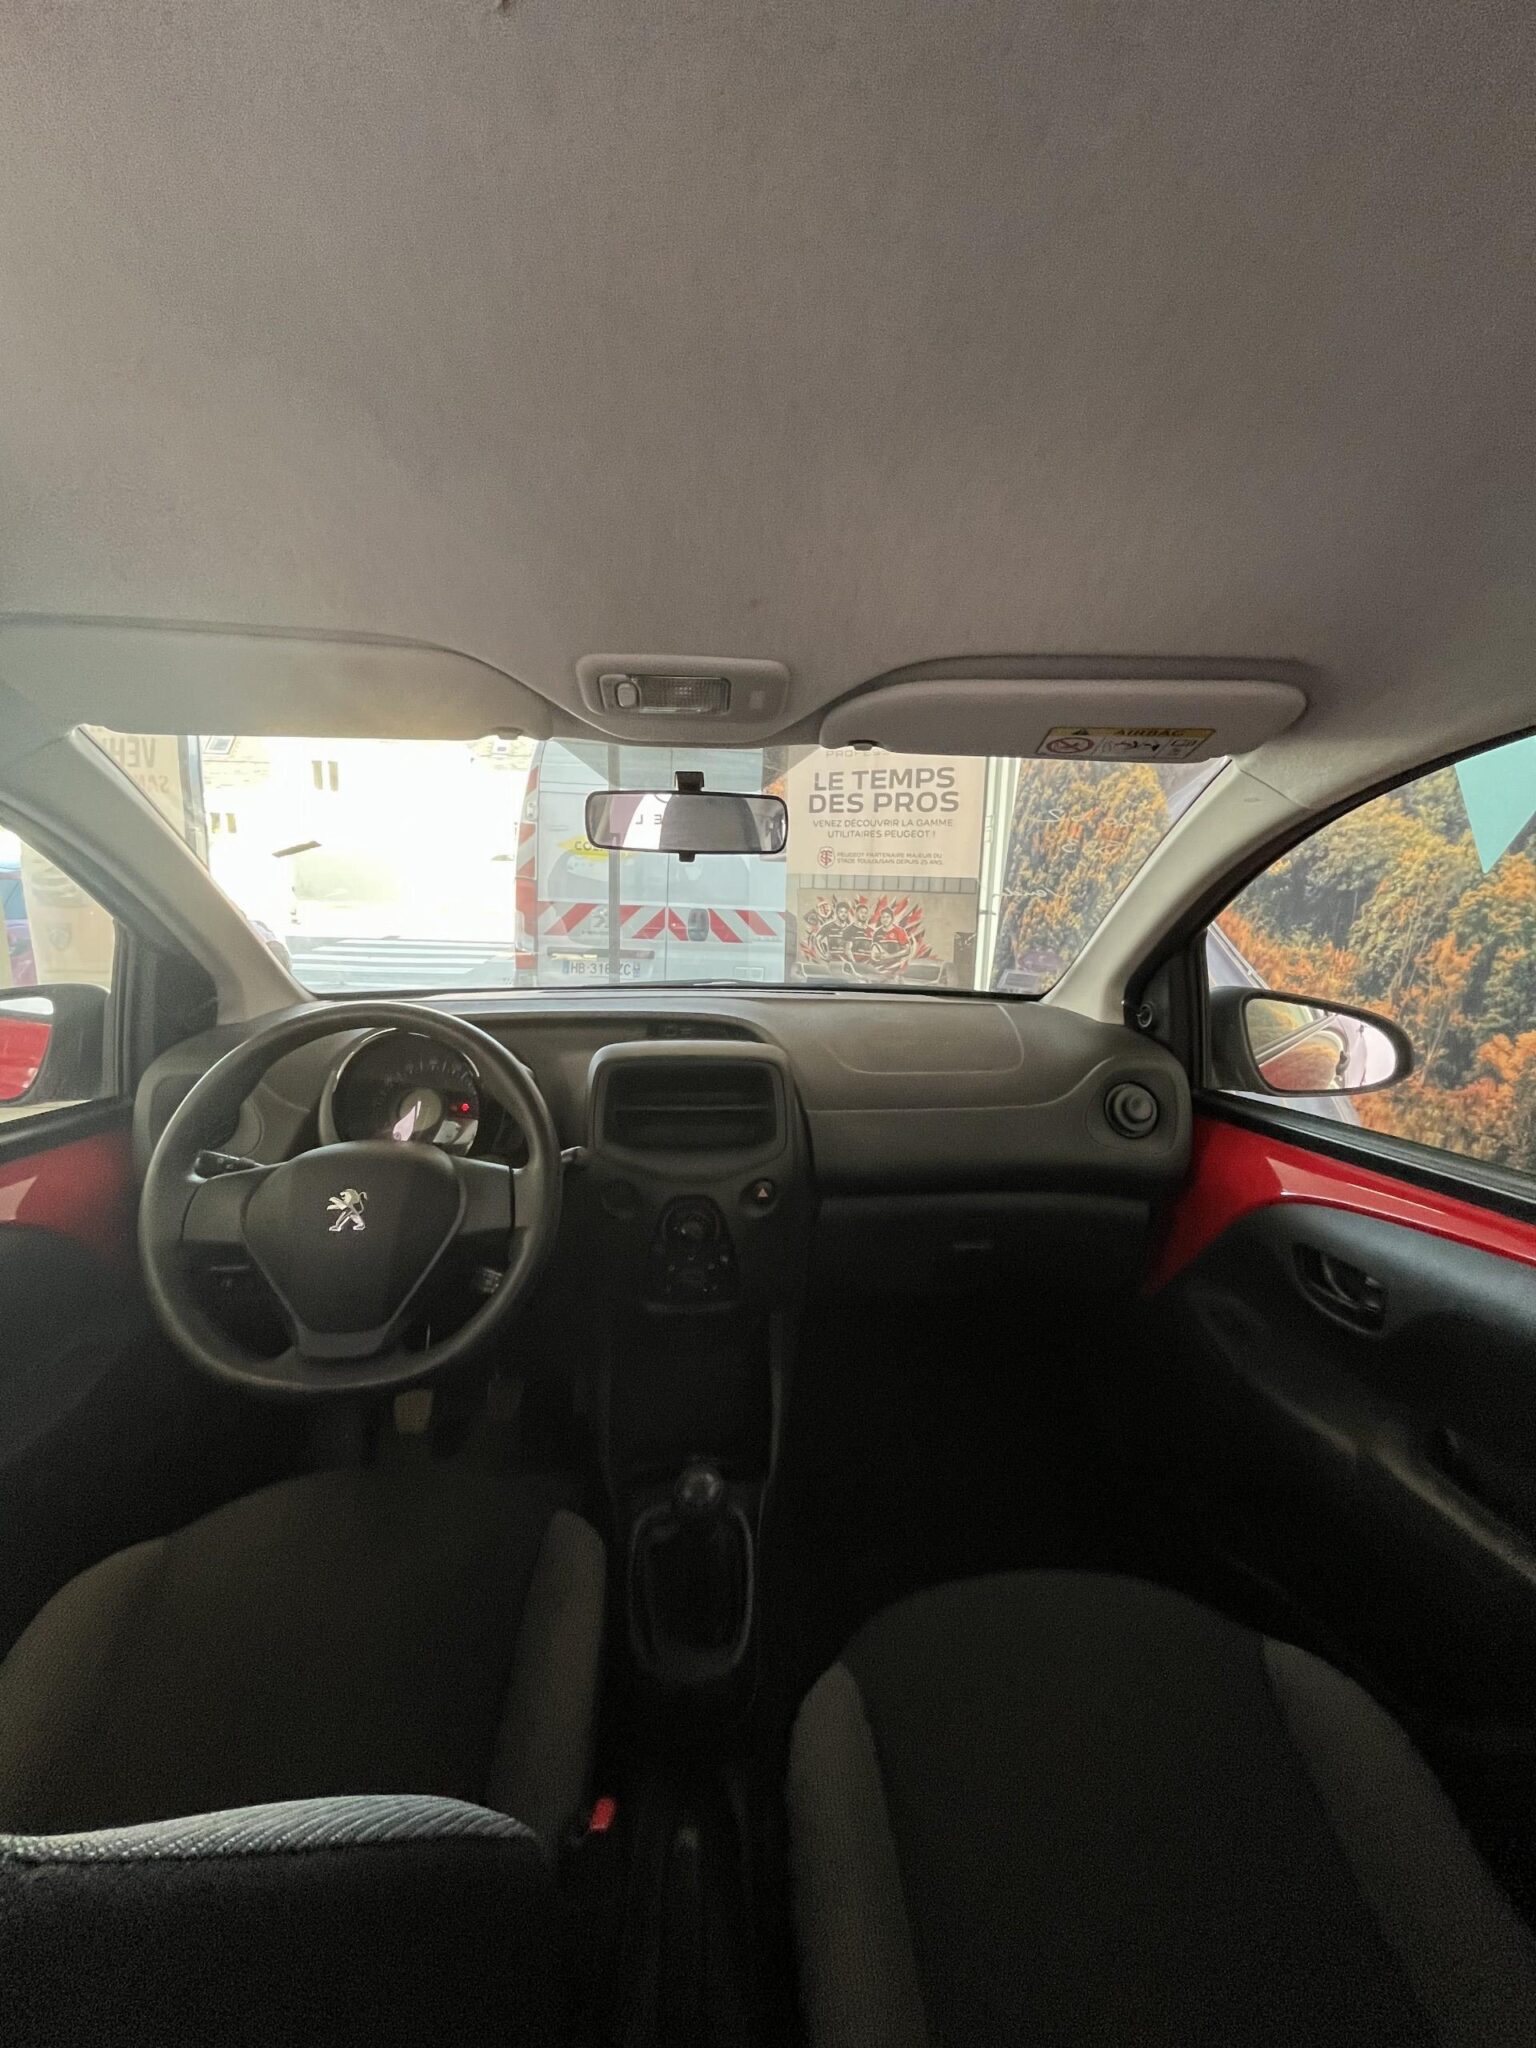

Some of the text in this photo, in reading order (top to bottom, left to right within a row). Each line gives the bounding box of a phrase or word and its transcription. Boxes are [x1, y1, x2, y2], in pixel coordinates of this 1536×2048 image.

[814, 767, 955, 791] LE TEMPS
[809, 791, 959, 814] DES PROS
[813, 819, 842, 828] VENEZ
[901, 819, 914, 828] LA
[916, 819, 953, 828] GAMME
[828, 830, 882, 838] UTILITAIRES
[884, 829, 930, 838] PEUGEOT
